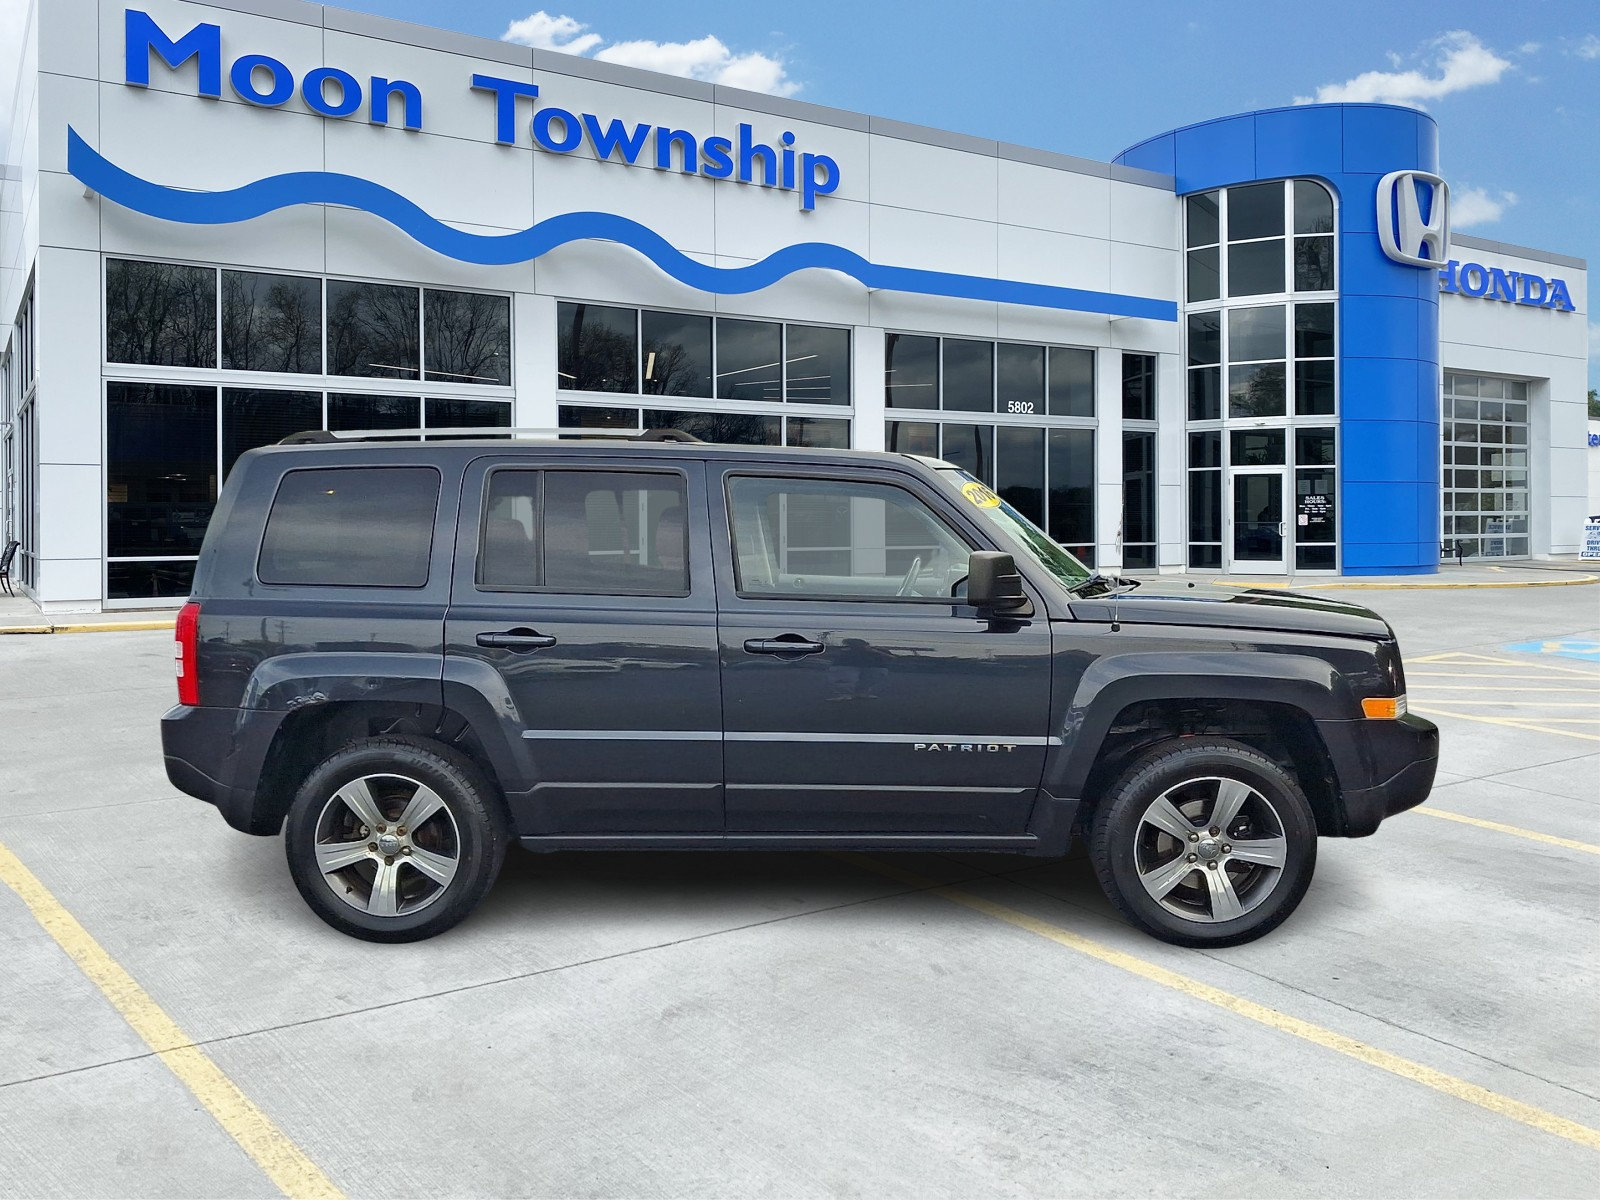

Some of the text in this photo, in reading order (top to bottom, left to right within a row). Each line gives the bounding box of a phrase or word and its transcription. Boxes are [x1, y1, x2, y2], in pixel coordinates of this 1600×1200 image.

[125, 8, 841, 212] Moon Township
[1008, 401, 1034, 414] 5802
[914, 743, 1017, 753] PATRIOT
